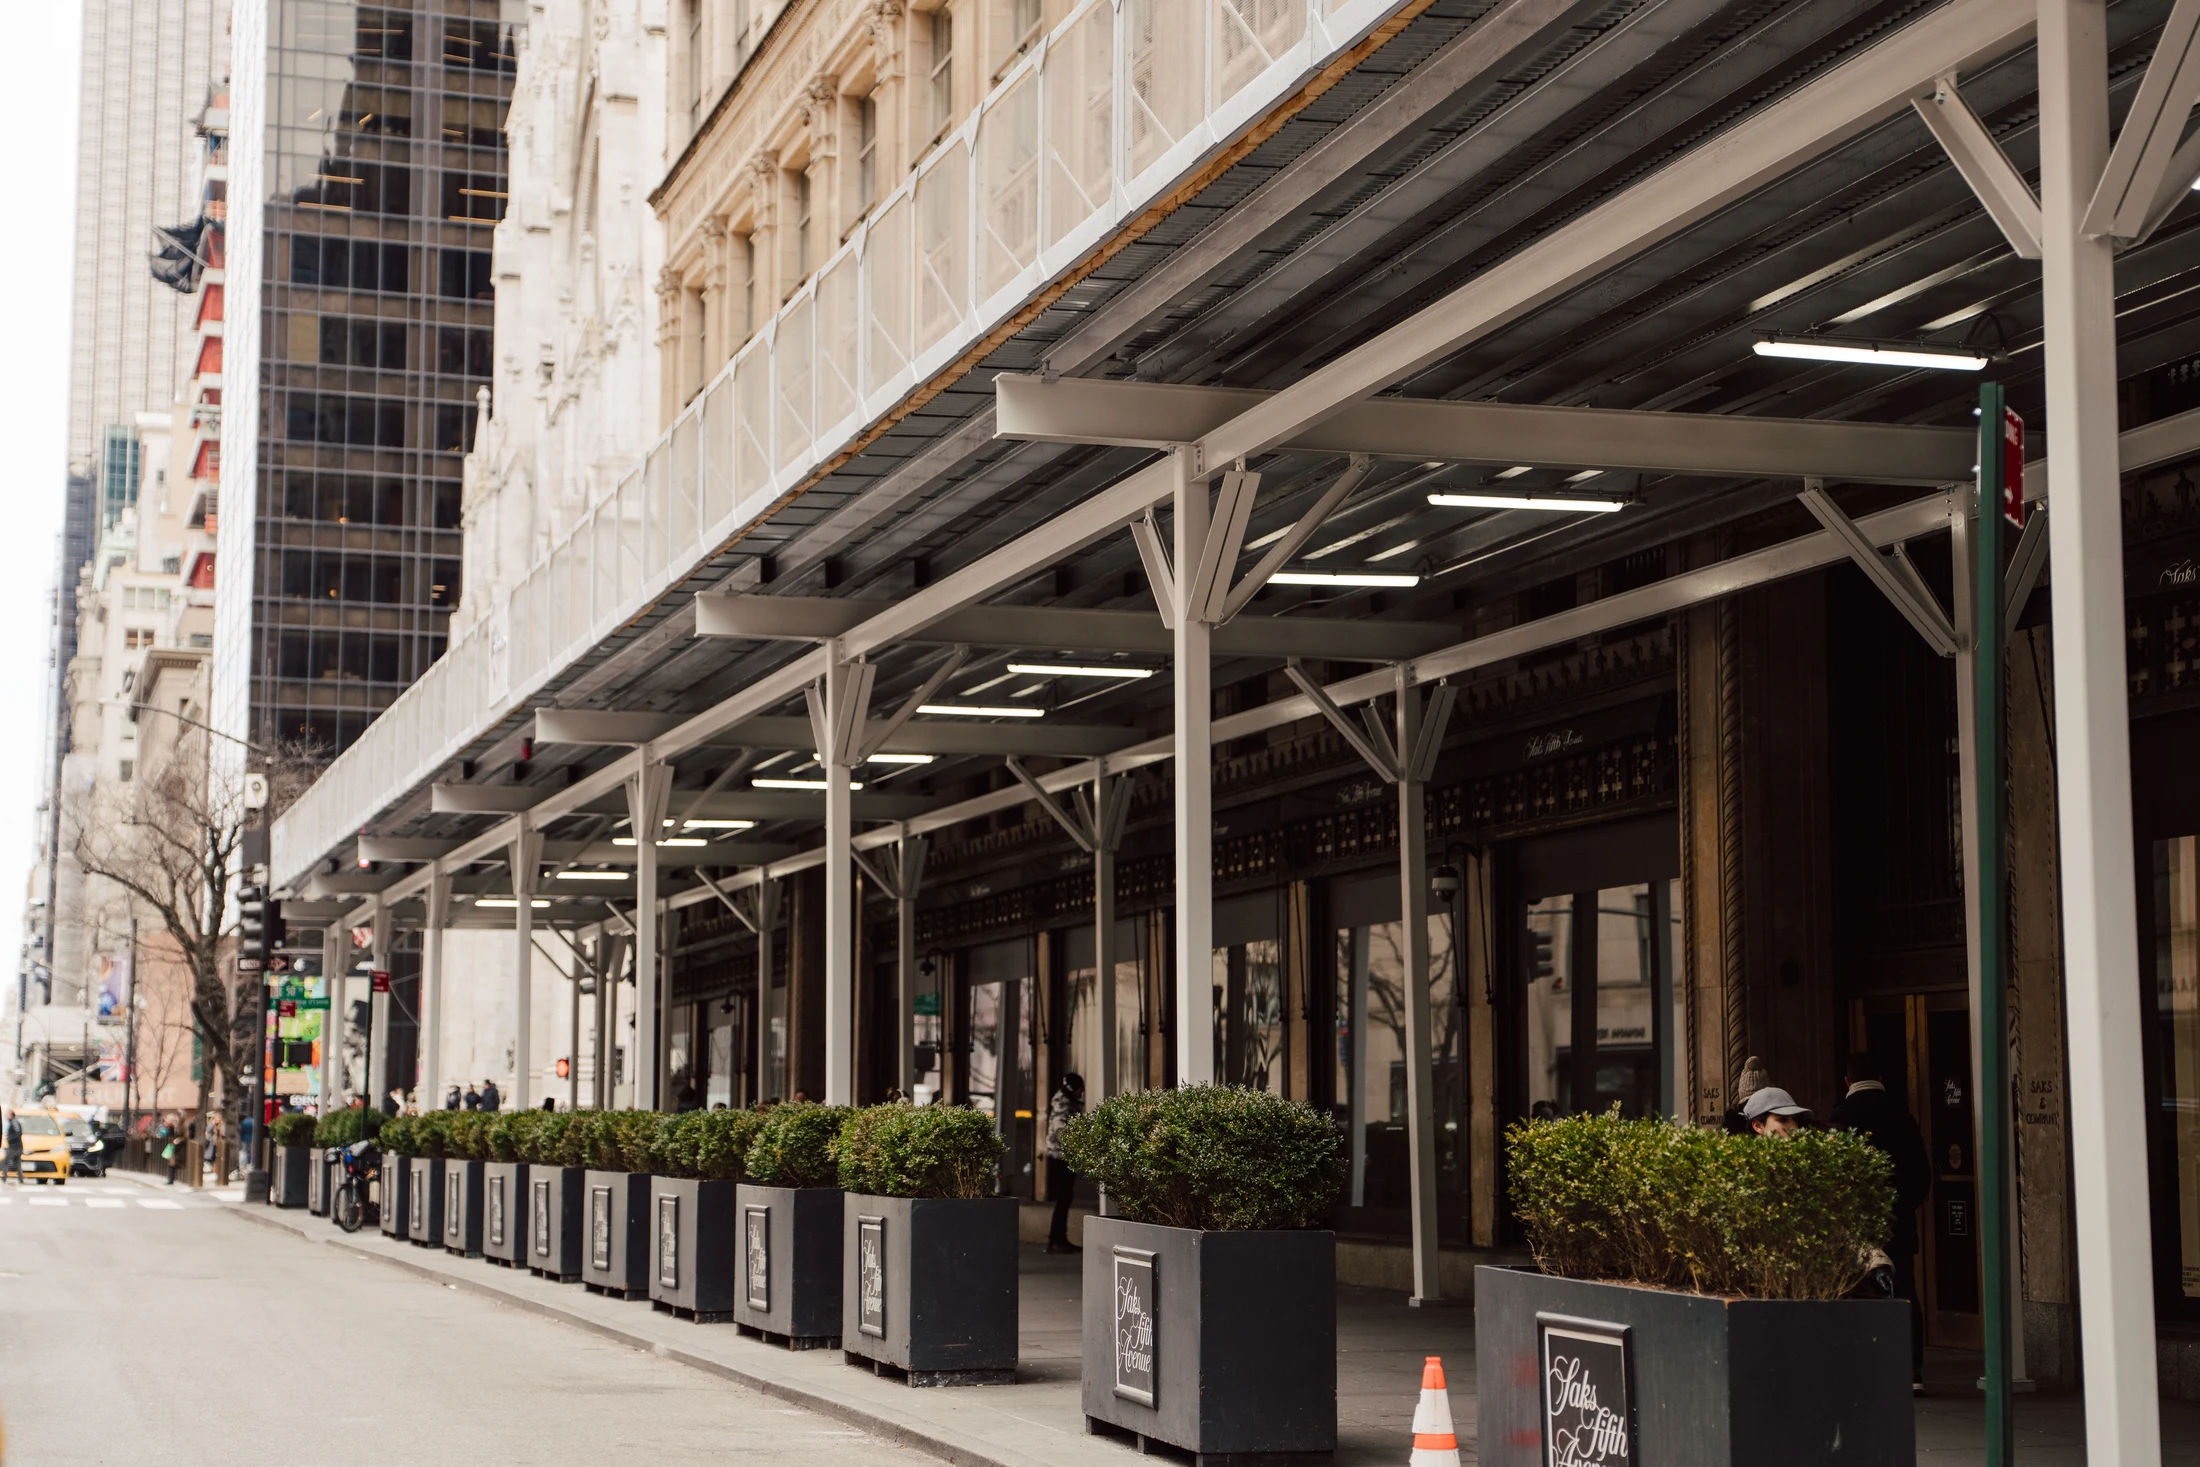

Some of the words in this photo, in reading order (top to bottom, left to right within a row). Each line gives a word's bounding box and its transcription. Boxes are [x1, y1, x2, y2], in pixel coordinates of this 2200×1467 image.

[1703, 1087, 1720, 1099] SAKS
[2030, 1080, 2053, 1093] SAKS
[289, 1094, 315, 1106] EDEN
[1709, 1101, 1715, 1112] &
[2039, 1097, 2047, 1110] &
[2025, 1113, 2058, 1125] COMPANY
[1117, 1276, 1142, 1320] Saks
[1118, 1328, 1152, 1373] Avenue
[1549, 1355, 1598, 1416] Saks
